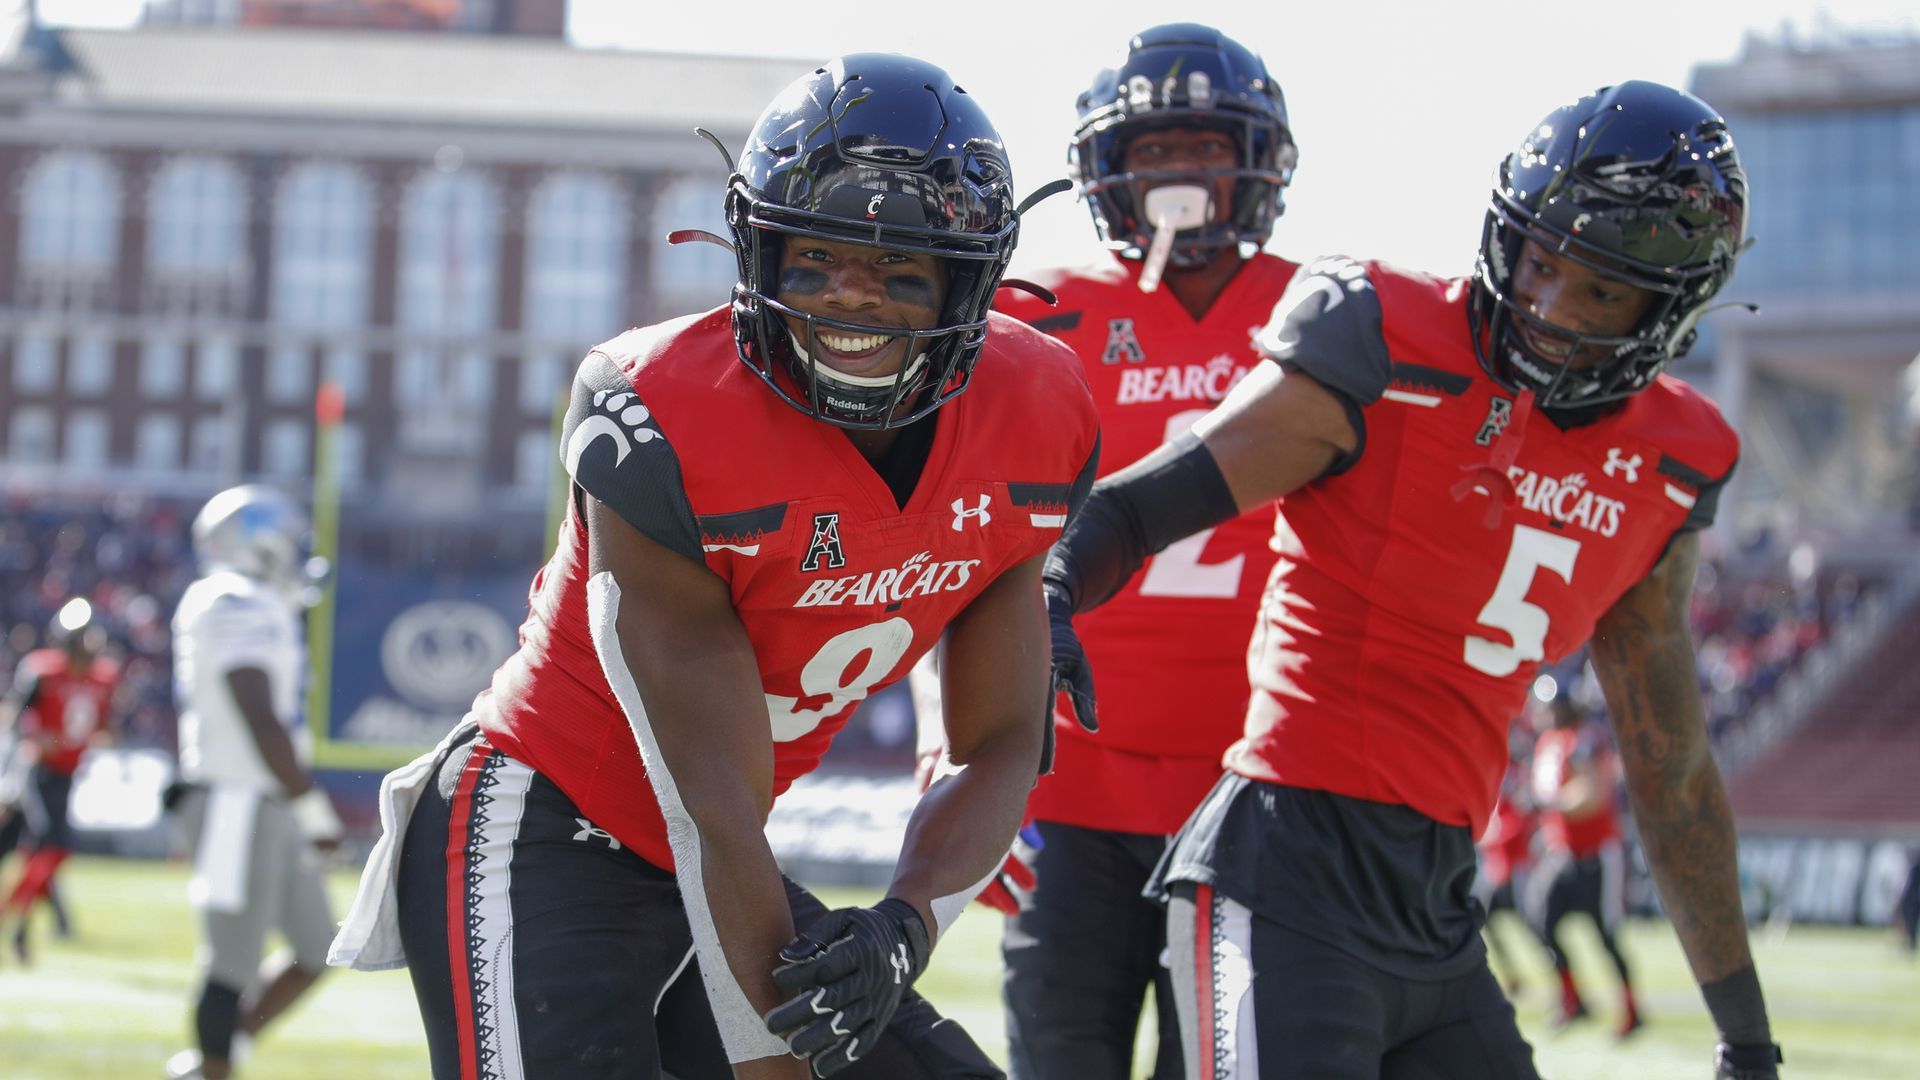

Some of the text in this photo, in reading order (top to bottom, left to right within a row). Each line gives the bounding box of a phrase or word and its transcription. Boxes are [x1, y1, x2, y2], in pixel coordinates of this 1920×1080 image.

[1116, 353, 1248, 405] BEARC
[1506, 465, 1626, 538] ARCATS
[793, 551, 980, 608] BEARCATS
[1464, 524, 1581, 677] 5
[764, 617, 913, 742] 9
